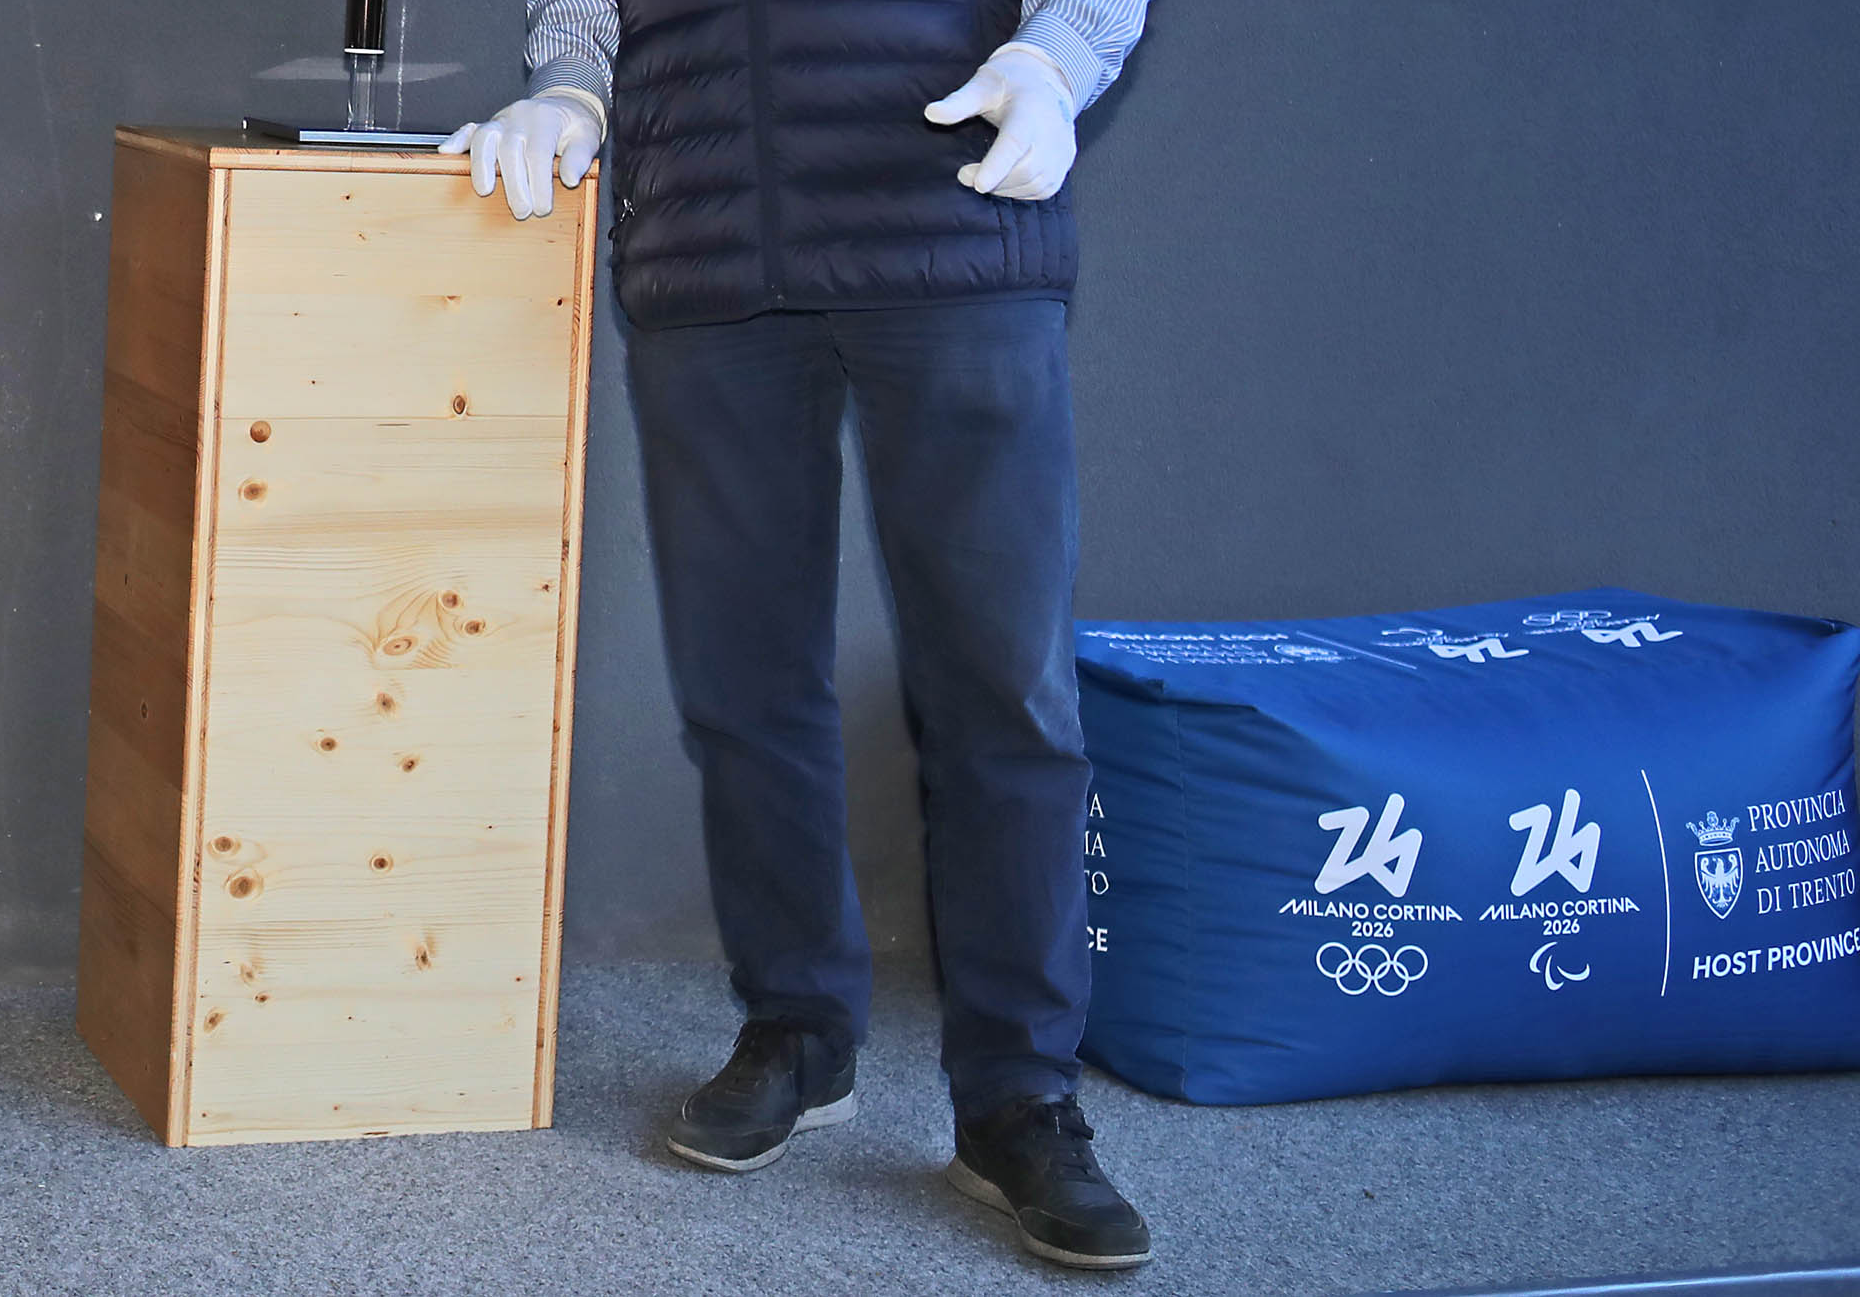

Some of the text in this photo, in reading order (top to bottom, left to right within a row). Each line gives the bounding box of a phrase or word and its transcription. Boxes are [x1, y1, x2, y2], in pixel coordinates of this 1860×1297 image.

[1747, 789, 1846, 832] PROVINCIA
[1314, 793, 1423, 898] 26
[1509, 788, 1601, 897] 26
[1755, 829, 1850, 873] AUTONOMA
[1279, 898, 1463, 921] MILANO CORTINA
[1479, 897, 1641, 921] MILANO CORTINA
[1757, 868, 1856, 914] DI TRENTO
[1351, 921, 1394, 938] 2026
[1543, 919, 1580, 935] 2026
[1692, 927, 1860, 980] HOST PROVINCE
